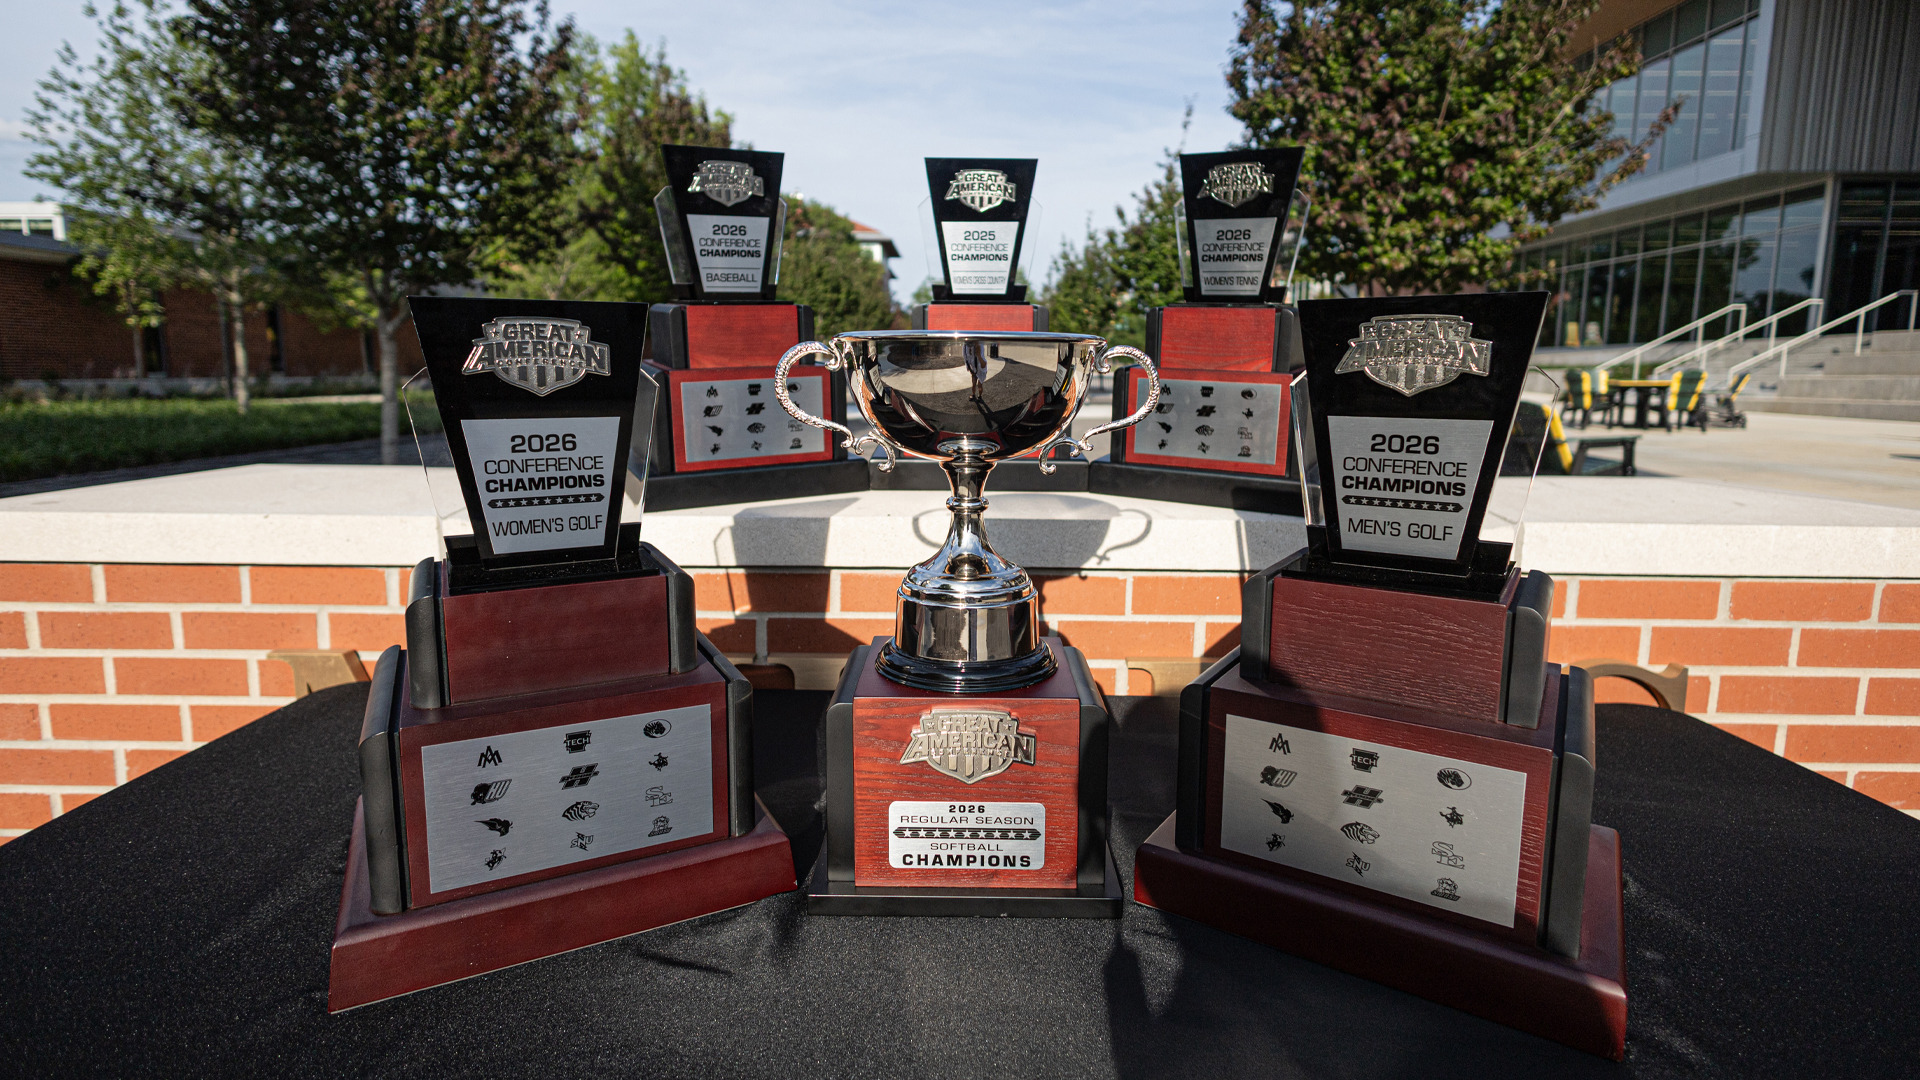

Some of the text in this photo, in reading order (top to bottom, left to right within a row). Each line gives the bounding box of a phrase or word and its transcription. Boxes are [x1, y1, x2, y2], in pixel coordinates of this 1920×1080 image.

[964, 172, 998, 182] GREAT
[951, 182, 1014, 199] AMERICAN
[712, 225, 747, 236] 2026
[964, 230, 996, 241] 2025
[1216, 229, 1252, 241] 2026
[699, 237, 761, 248] CONFERENCE
[951, 243, 1009, 252] CONFERENCE
[1202, 242, 1265, 253] CONFERENCE
[700, 248, 761, 258] CHAMPIONS
[951, 253, 1009, 261] CHAMPIONS
[1201, 253, 1264, 263] CHAMPIONS
[706, 272, 758, 283] BASEBALL
[1204, 276, 1259, 286] WOMEN'S TENNIS
[502, 323, 575, 342] GREAT
[474, 340, 607, 371] AMERICAN
[510, 433, 577, 454] 2026
[1370, 433, 1440, 455] 2026
[484, 455, 604, 475] CONFERENCE
[1343, 456, 1468, 478] CONFERENCE
[485, 474, 605, 493] CHAMPIONS
[1341, 475, 1466, 497] CHAMPIONS
[492, 515, 603, 537] WOMEN'S GOLF
[1348, 518, 1454, 541] MEN'S GOLF
[937, 714, 1004, 733] GREAT
[566, 737, 590, 747] TECH
[906, 731, 1033, 763] AMERICAN
[1351, 755, 1377, 766] TECH
[1272, 769, 1297, 787] HU
[485, 780, 512, 800] HU
[948, 804, 986, 814] 2026
[900, 815, 1034, 825] REGULAR SEASON
[930, 843, 1004, 851] SOFTBALL
[902, 854, 1031, 868] CHAMPIONS
